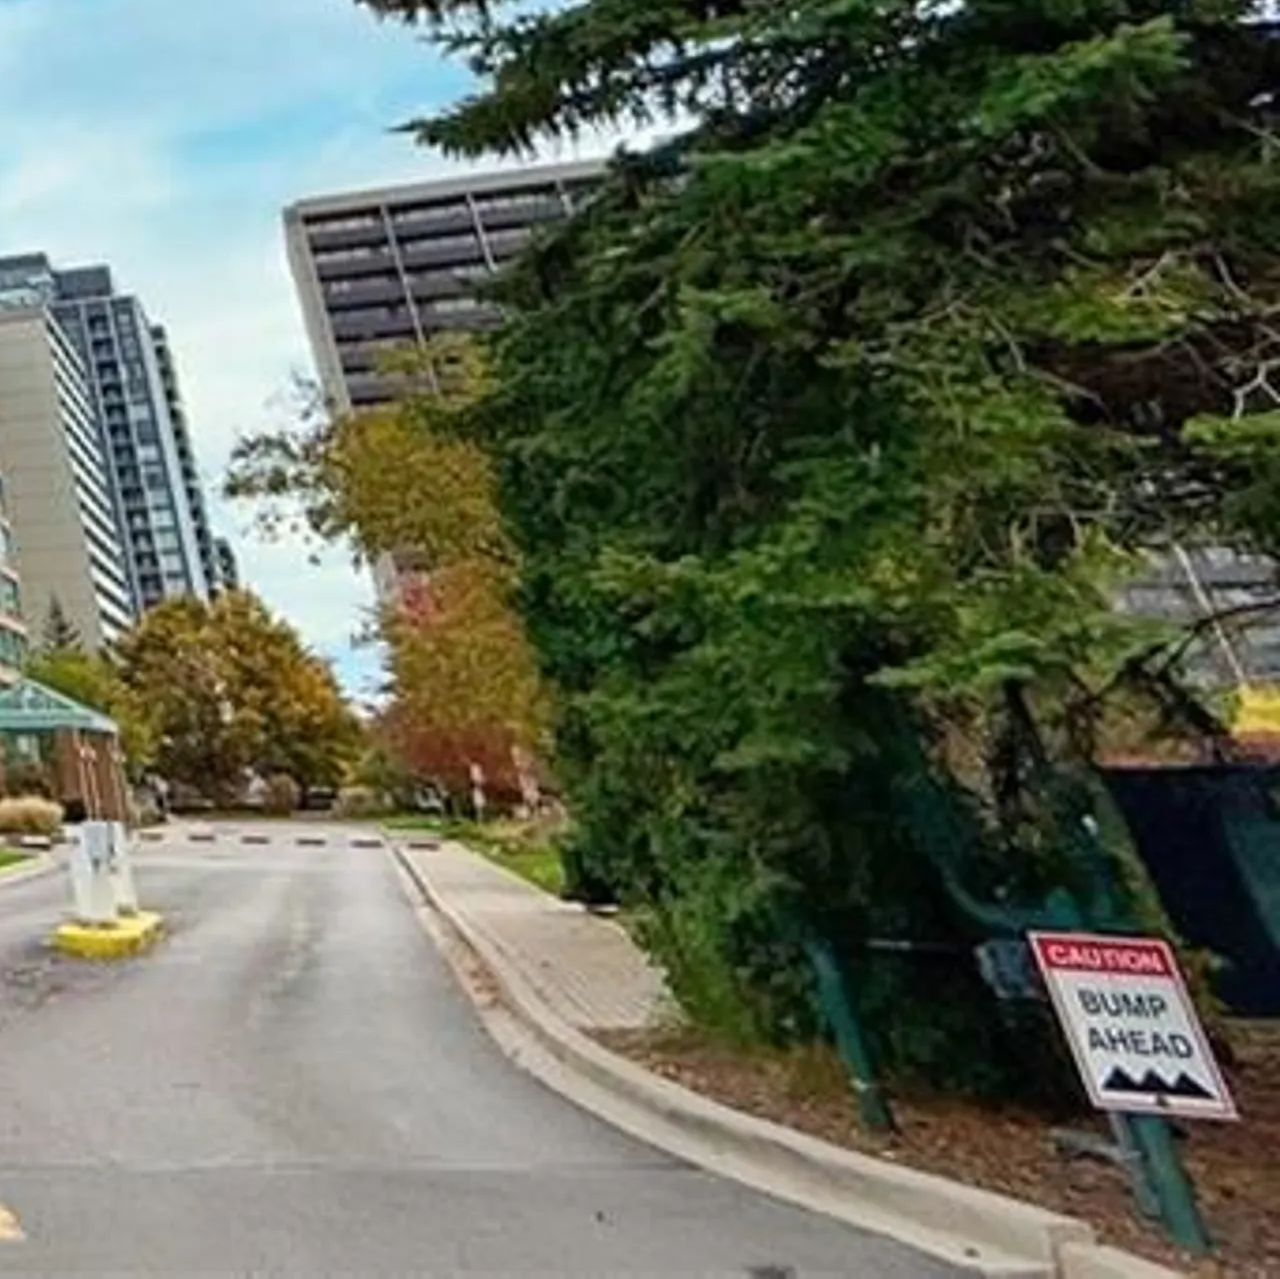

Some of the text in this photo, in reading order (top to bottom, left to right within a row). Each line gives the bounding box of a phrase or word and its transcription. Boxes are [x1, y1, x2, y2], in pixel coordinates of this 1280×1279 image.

[1046, 943, 1165, 972] CAUTION
[1077, 988, 1167, 1019] BUMP
[1088, 1026, 1194, 1059] AHEAD
